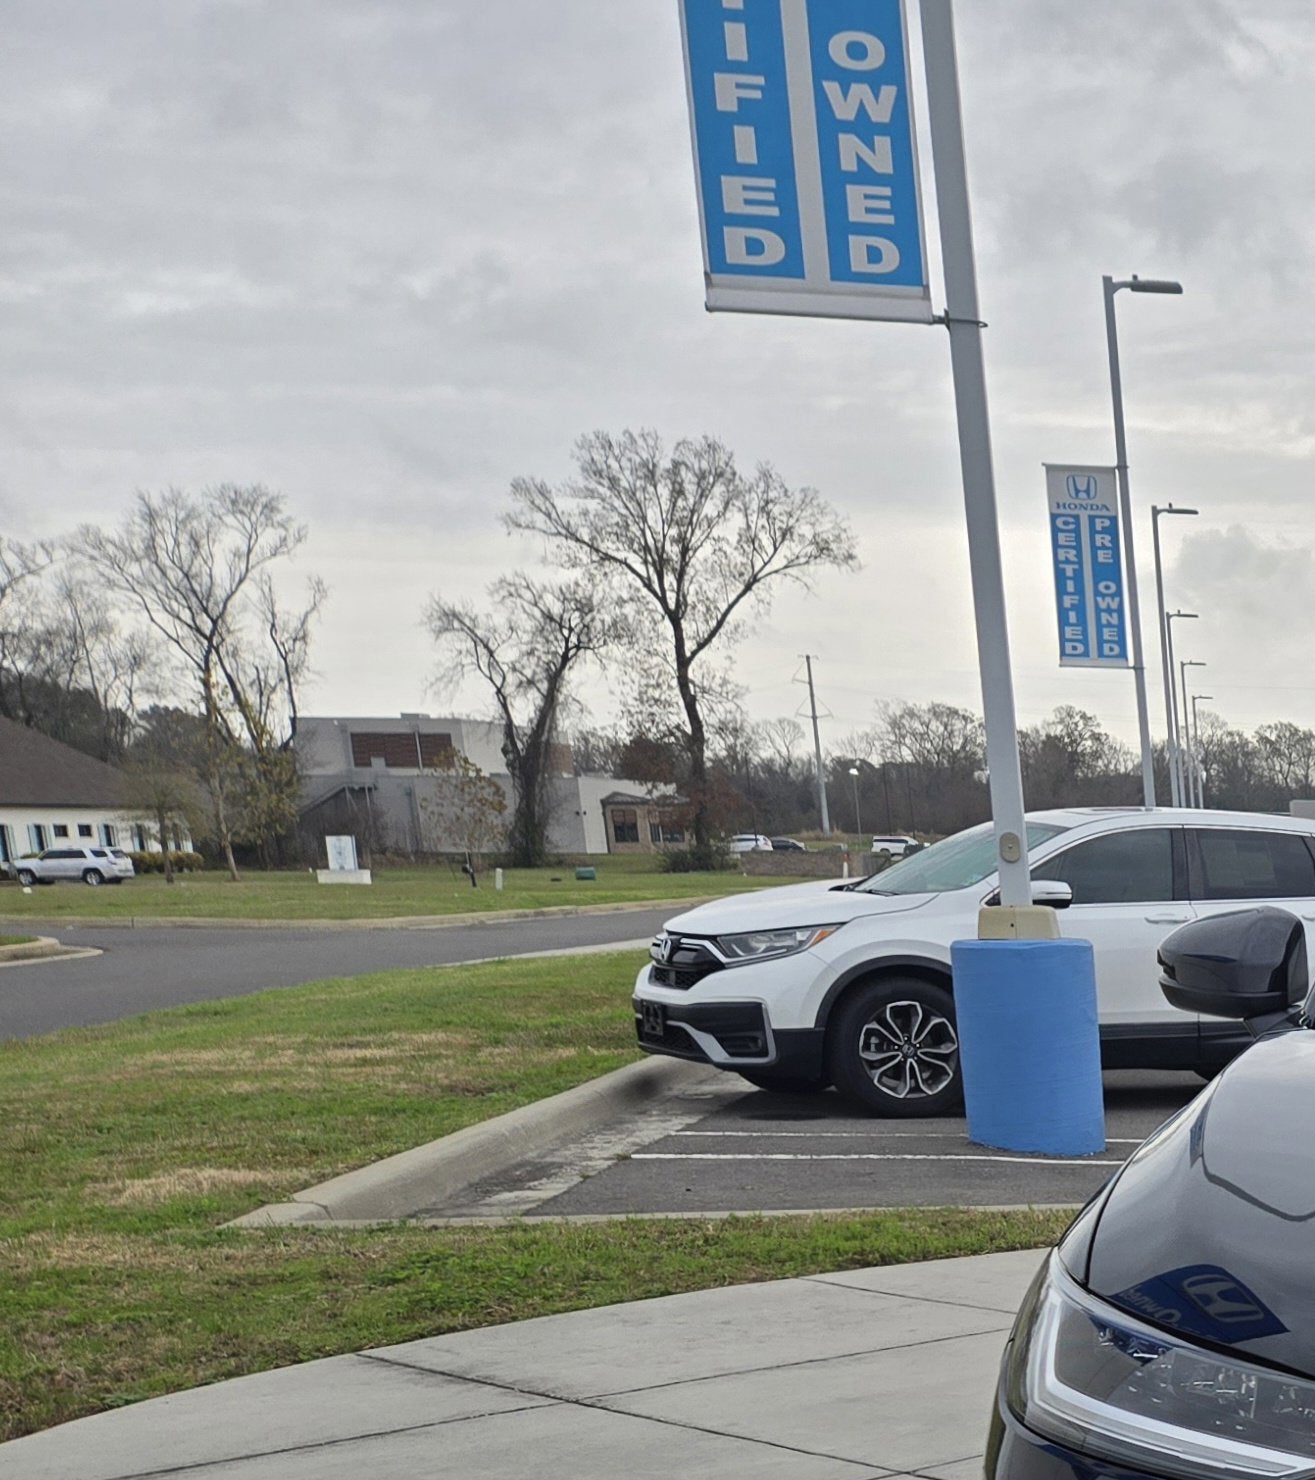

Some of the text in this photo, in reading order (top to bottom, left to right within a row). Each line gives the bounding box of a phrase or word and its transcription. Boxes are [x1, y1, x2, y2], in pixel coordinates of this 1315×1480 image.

[714, 0, 786, 266] IFIED
[821, 31, 901, 274] OWNED
[1055, 502, 1111, 513] HONDA
[1055, 516, 1085, 656] CERTIFIED
[1094, 517, 1120, 656] PRE OWNED
